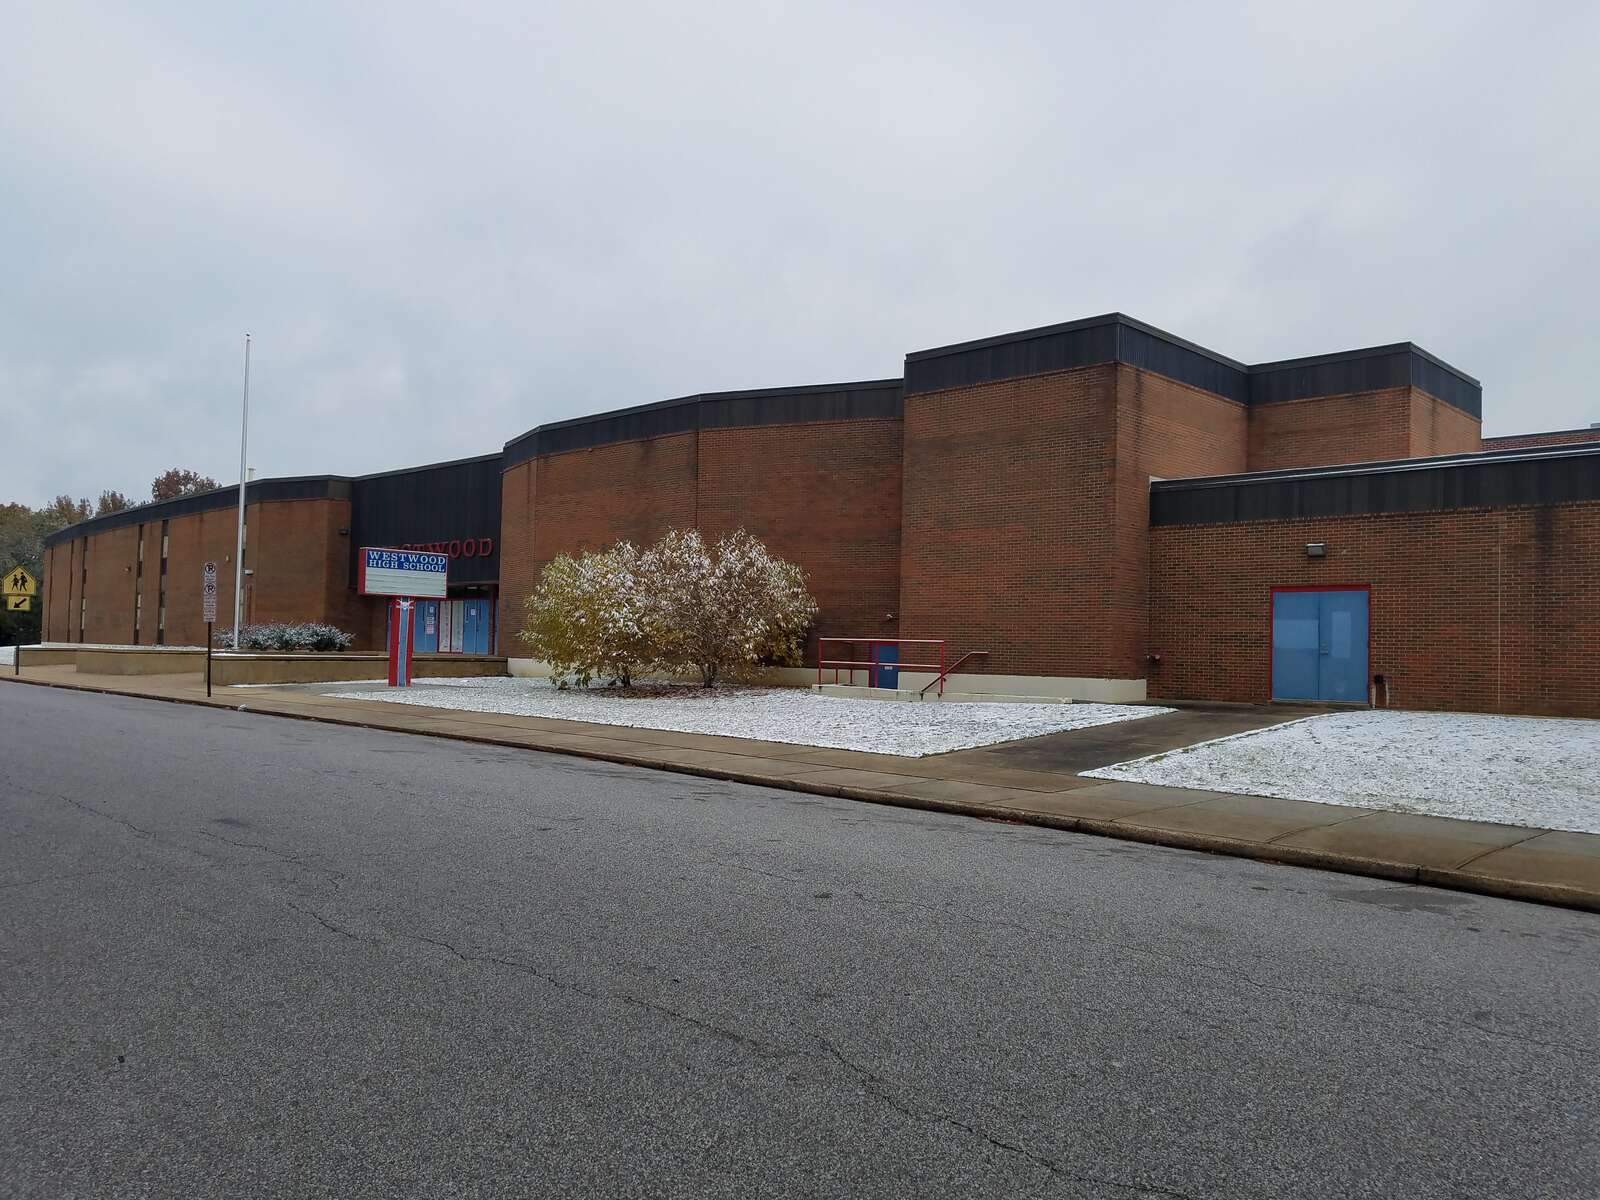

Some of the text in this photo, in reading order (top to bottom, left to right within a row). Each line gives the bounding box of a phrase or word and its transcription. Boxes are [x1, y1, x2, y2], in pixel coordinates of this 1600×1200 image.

[368, 551, 446, 565] WESTWOOD
[369, 559, 445, 572] HIGH SCHOOL
